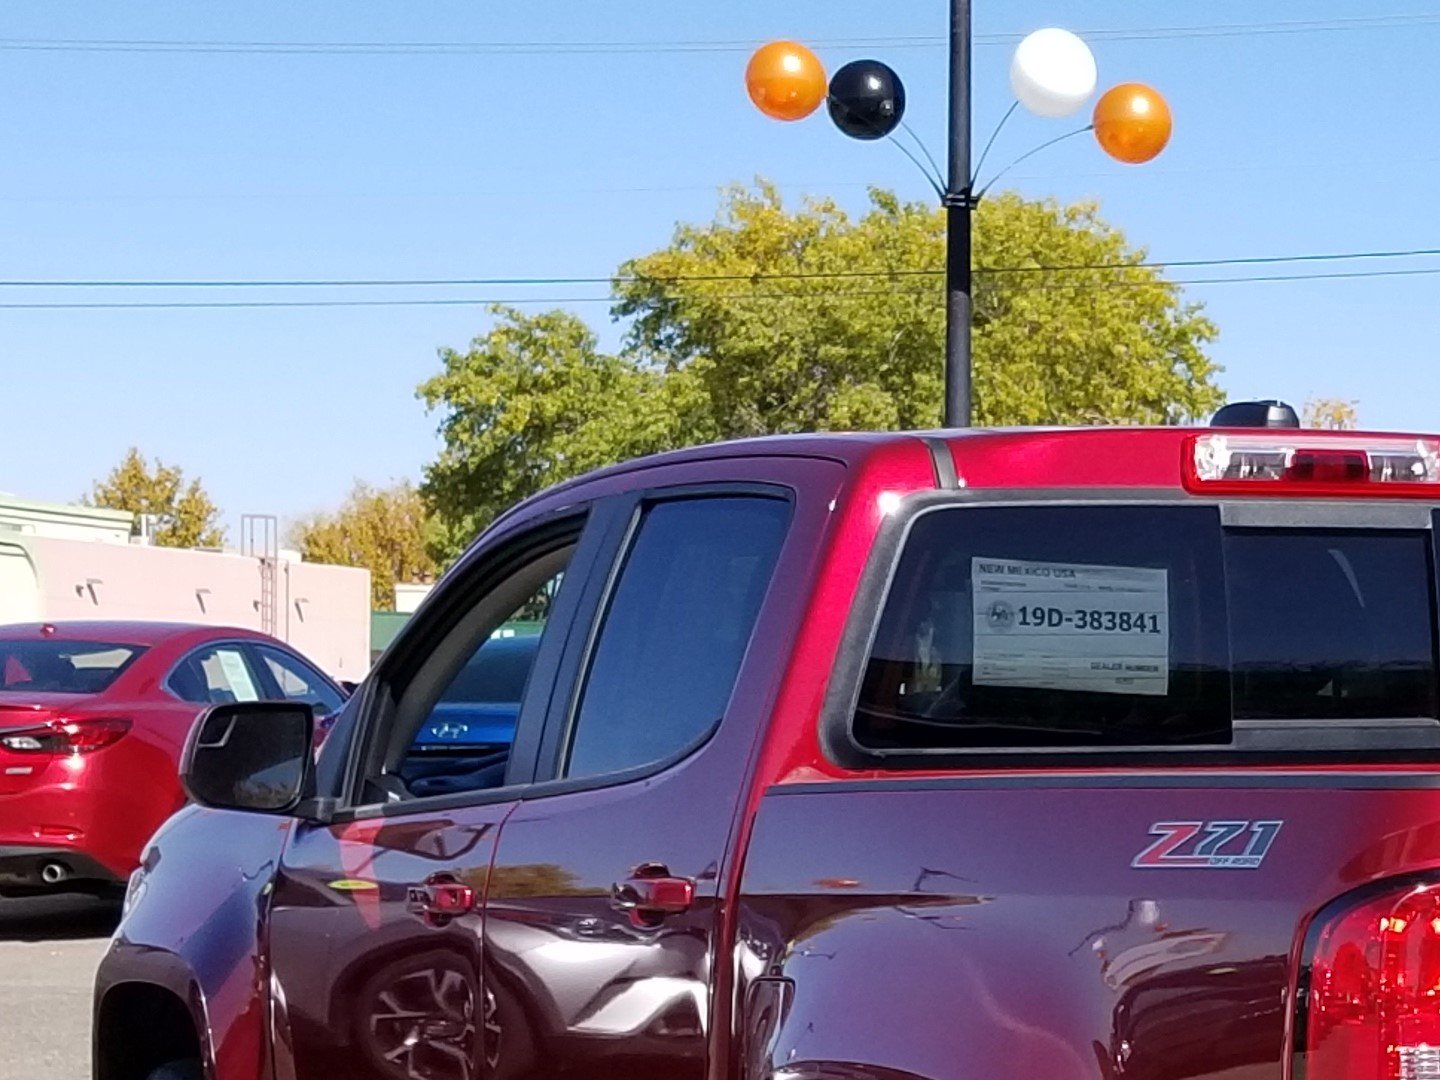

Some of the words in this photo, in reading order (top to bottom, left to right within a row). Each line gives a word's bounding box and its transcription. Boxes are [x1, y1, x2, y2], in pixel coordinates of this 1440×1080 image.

[979, 563, 1004, 574] NEW
[1007, 565, 1050, 577] MEXICO
[1053, 567, 1077, 579] USA
[1018, 605, 1162, 634] 19D-383841
[1131, 820, 1284, 869] Z71
